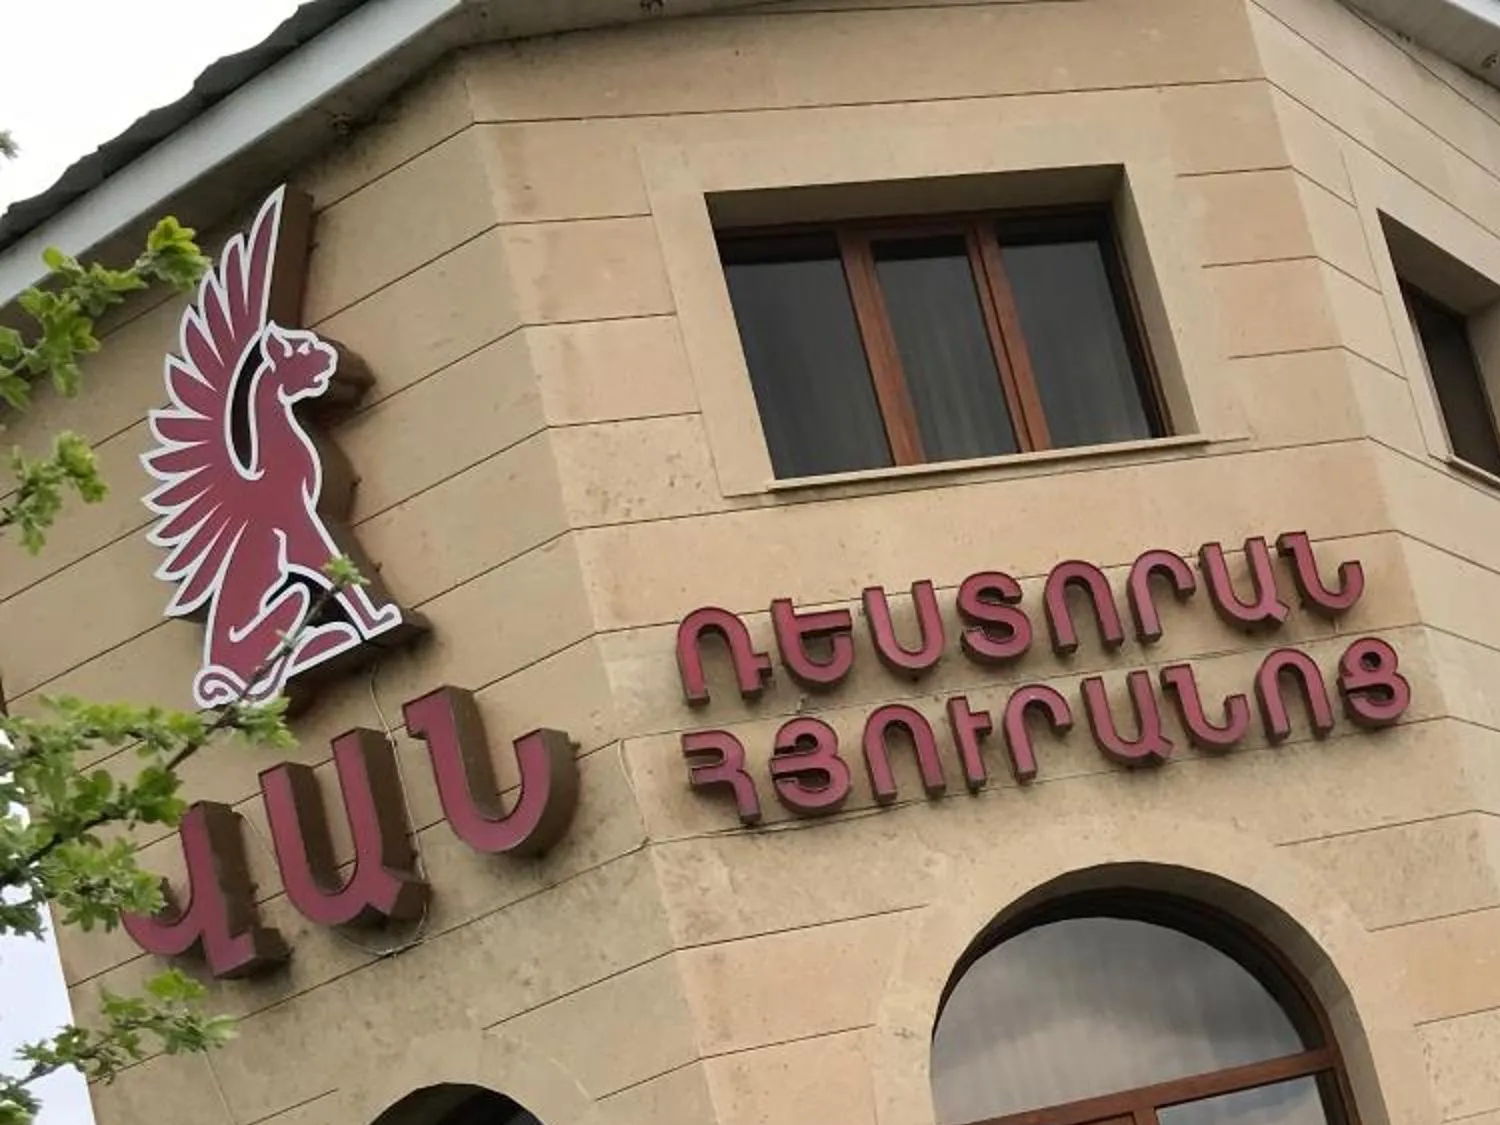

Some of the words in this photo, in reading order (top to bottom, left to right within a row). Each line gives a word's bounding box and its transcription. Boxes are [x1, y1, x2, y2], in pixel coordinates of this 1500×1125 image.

[675, 530, 1366, 706] ՌԵՍՏՈՐԱՆ
[681, 635, 1413, 826] ՀՅՈՒՐԱՆՈՑ
[118, 684, 580, 980] ՎԱՆ
